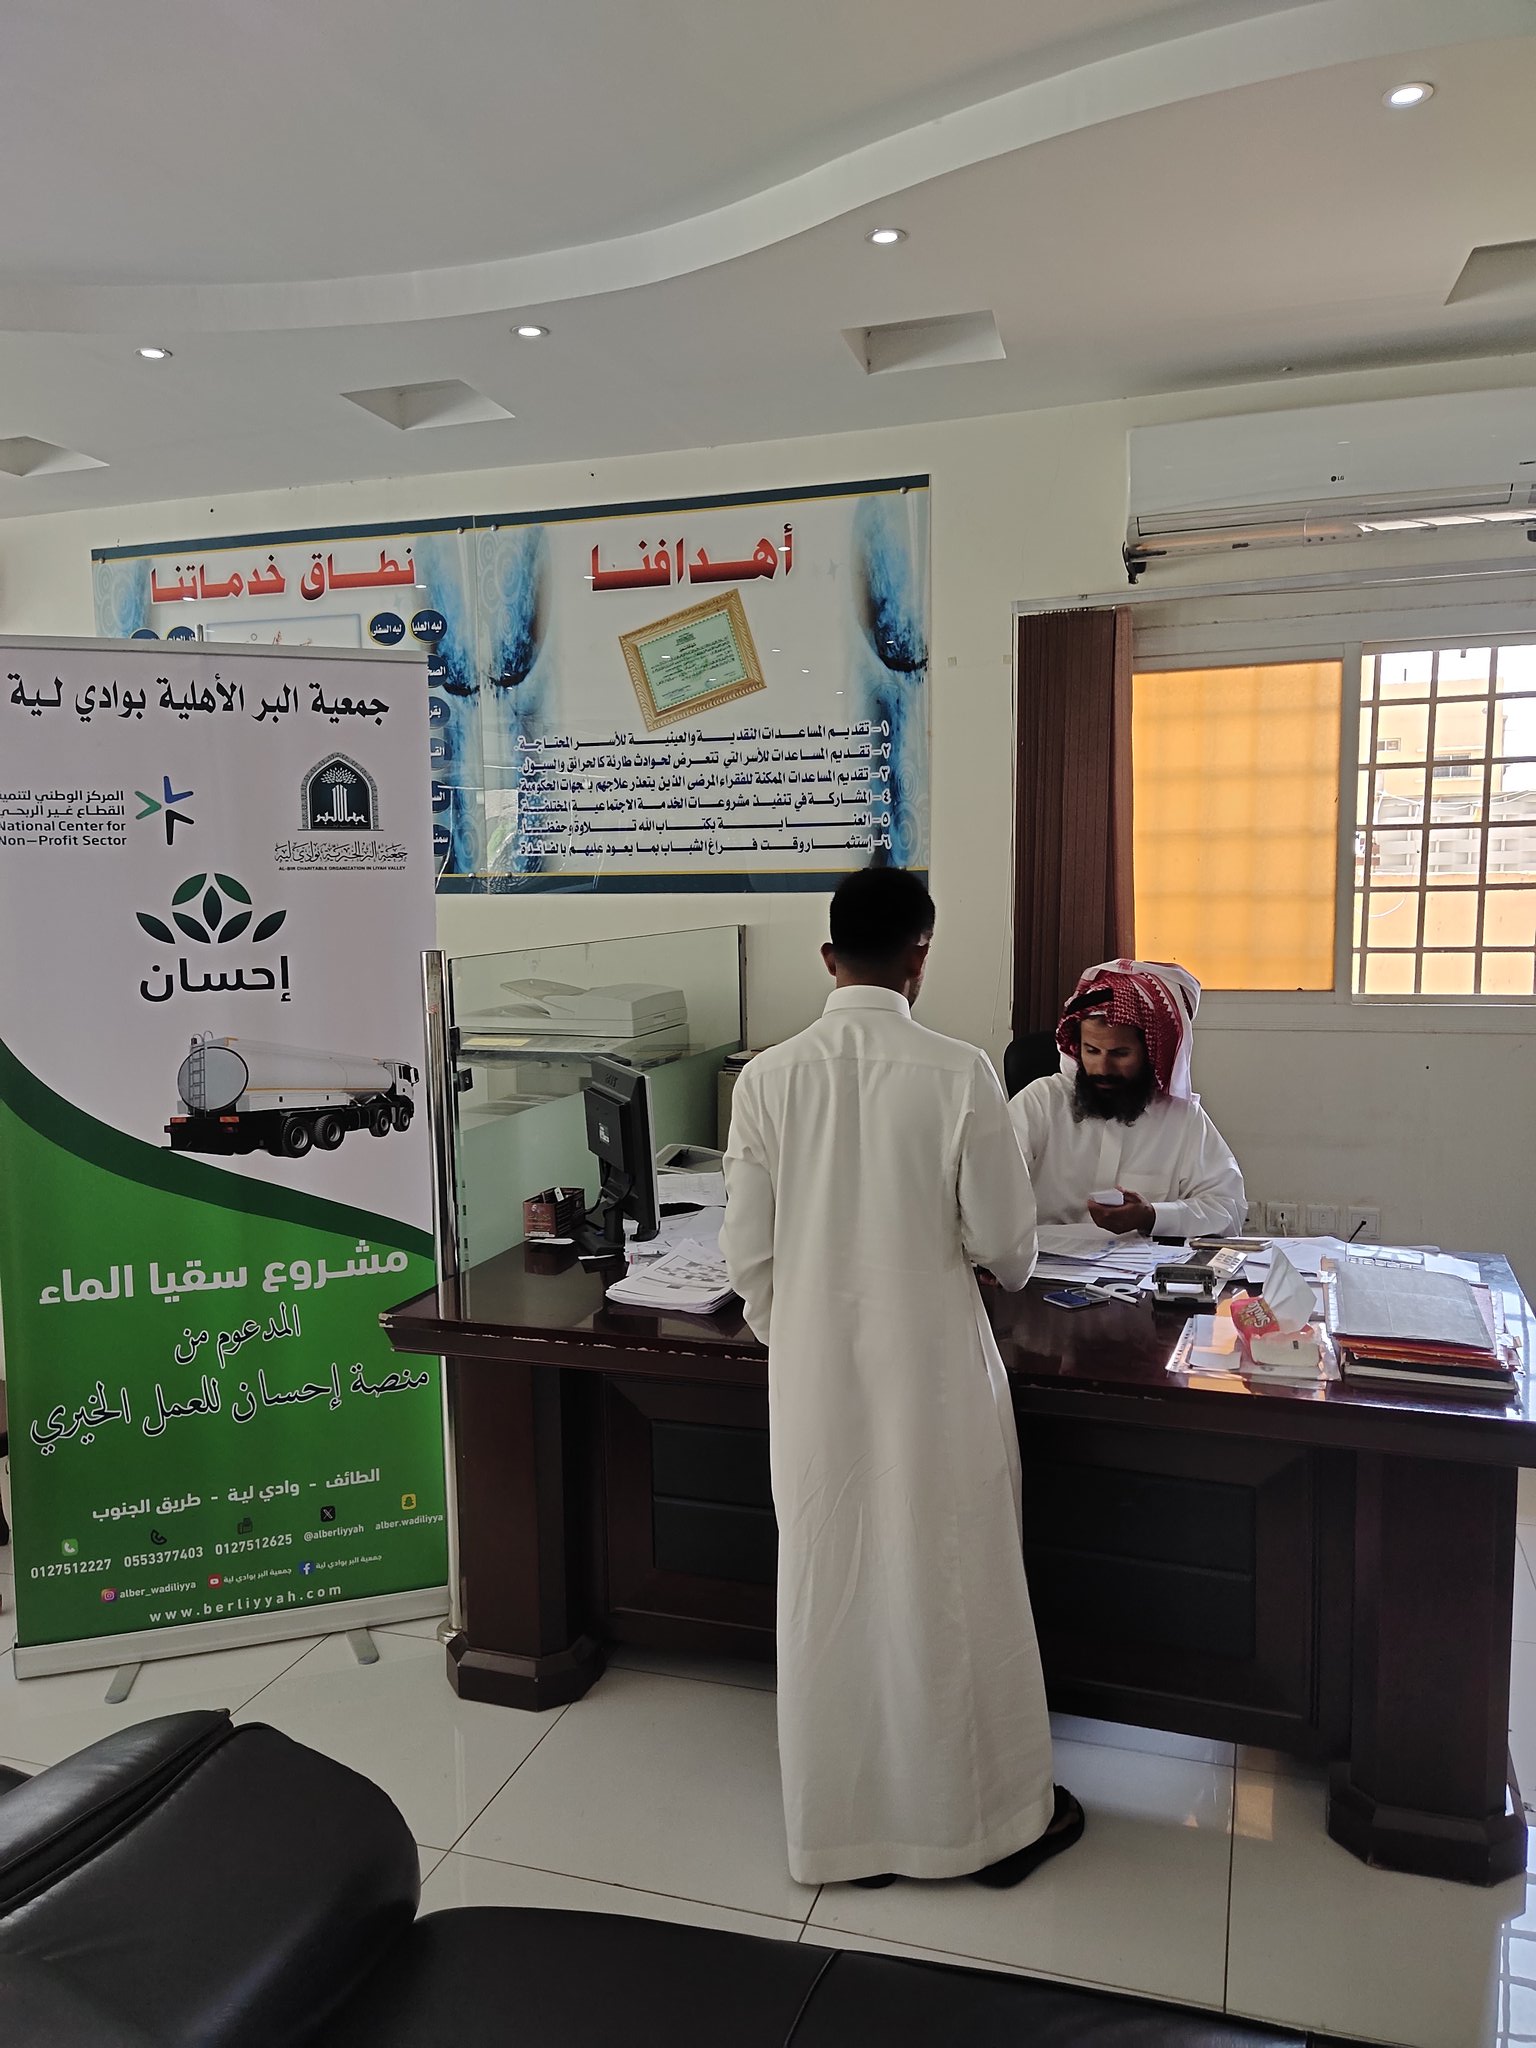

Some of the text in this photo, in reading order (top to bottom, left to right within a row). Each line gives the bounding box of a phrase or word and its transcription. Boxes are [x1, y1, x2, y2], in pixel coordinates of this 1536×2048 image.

[591, 523, 793, 591] أهدافنا
[150, 547, 415, 603] نطاق خدماتنا
[7, 672, 390, 726] جمعية البر الأهلية بوادي لية
[828, 722, 870, 740] تقديم
[634, 754, 671, 768] لحوادث
[723, 752, 742, 767] التي
[831, 745, 870, 763] تقديم
[658, 776, 685, 791] الذين
[837, 768, 869, 786] تقديم
[0, 790, 124, 804] المركز الوطني لتنمي
[753, 793, 792, 809] تنفيذ
[794, 793, 808, 812] في
[47, 805, 73, 818] غير
[77, 805, 125, 818] القطاع
[0, 820, 126, 831] National Center for
[82, 835, 127, 846] Sector
[606, 844, 633, 857] يعود
[636, 843, 659, 857] بما
[140, 955, 292, 1003] إحسان
[38, 1240, 409, 1306] مشروع سقيا الماء
[174, 1301, 301, 1369] المدعوم من
[30, 1362, 430, 1456] منصة إحسان للعمل الخيري
[326, 1468, 380, 1489] الطائف
[227, 1486, 254, 1505] لية
[259, 1480, 299, 1502] وادي
[92, 1498, 150, 1522] الجنوب
[156, 1493, 201, 1515] طريق
[375, 1513, 444, 1531] alber.wadiliyya
[303, 1524, 365, 1542] @alberliyyah
[215, 1533, 293, 1556] 0127512625
[124, 1546, 204, 1568] 0553377403
[30, 1558, 112, 1579] 0127512227
[119, 1581, 197, 1599] alber_wadiliyya
[150, 1586, 341, 1623] www.berliyyah.com
